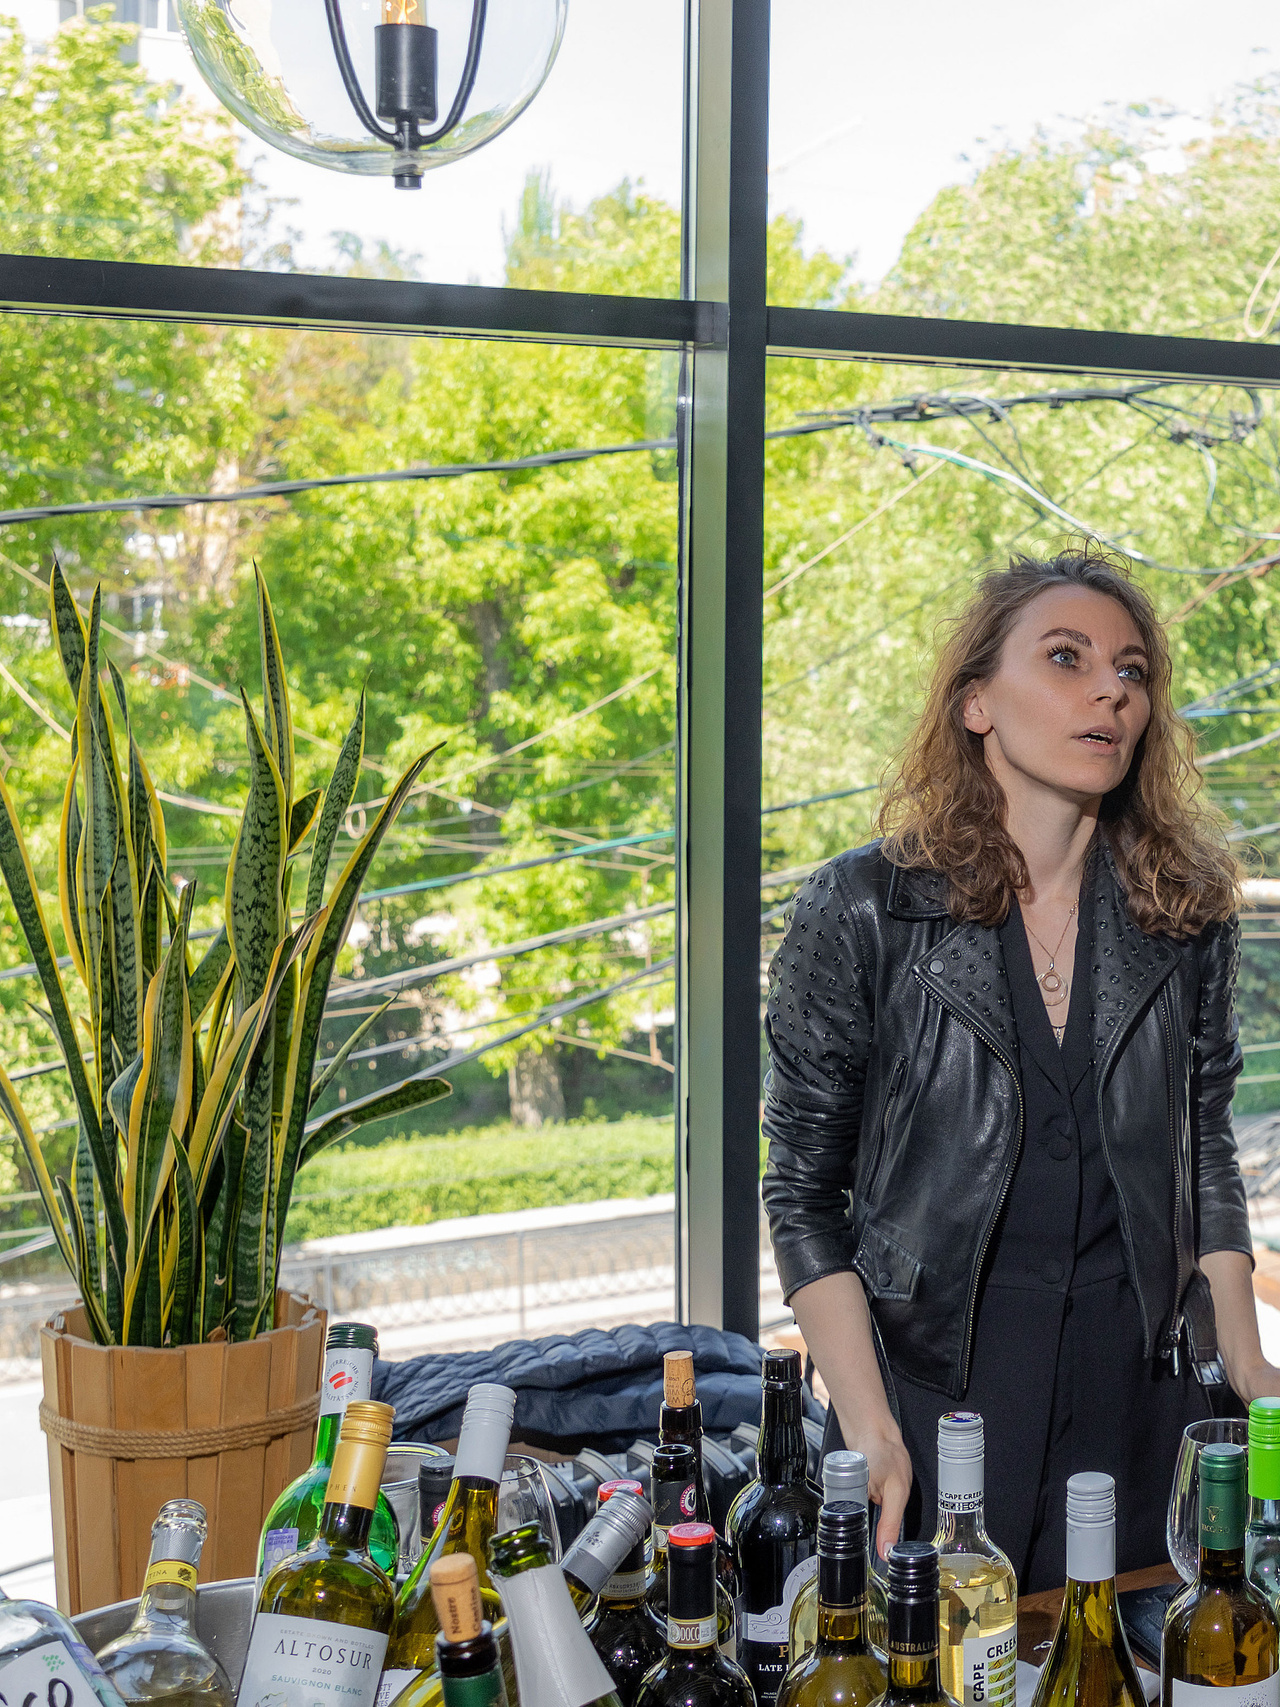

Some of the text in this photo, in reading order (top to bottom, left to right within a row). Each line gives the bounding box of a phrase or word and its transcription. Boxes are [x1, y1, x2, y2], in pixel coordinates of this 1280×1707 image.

[351, 1640, 375, 1650] BOTTLED
[890, 1640, 935, 1653] AUSTRALIA
[274, 1639, 372, 1670] ALTOSUR
[312, 1667, 332, 1675] 2020
[758, 1663, 783, 1672] LATE
[271, 1674, 363, 1696] SAUVIGNON BLANC
[973, 1662, 985, 1703] CAPE
